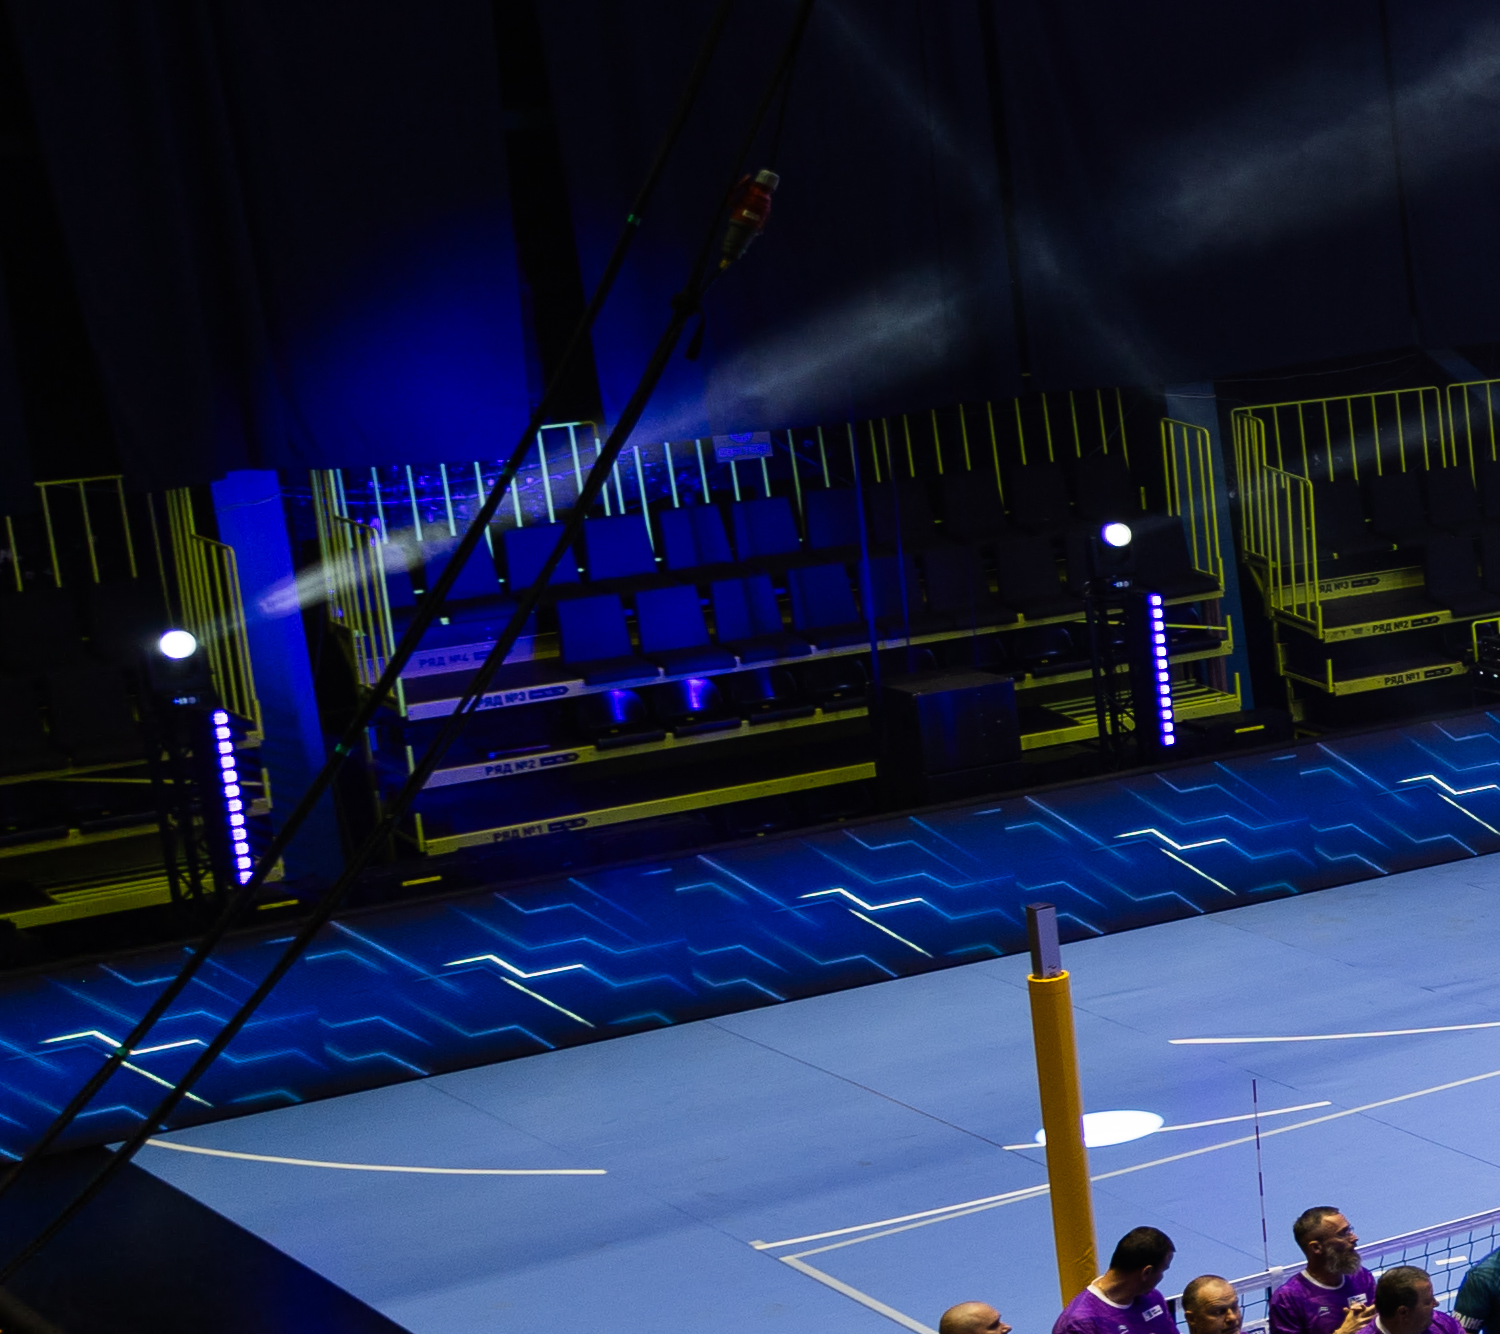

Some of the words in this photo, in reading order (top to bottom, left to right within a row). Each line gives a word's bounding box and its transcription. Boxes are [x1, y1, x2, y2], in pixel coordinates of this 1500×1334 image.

[1372, 622, 1391, 633] РЯД
[1394, 619, 1409, 630] №2
[420, 656, 444, 668] РЯД
[1384, 674, 1404, 685] РЯД
[1405, 671, 1421, 681] №1
[505, 690, 527, 703] №3
[485, 763, 512, 776] РЯД
[516, 759, 537, 771] №2
[494, 830, 520, 843] РЯД
